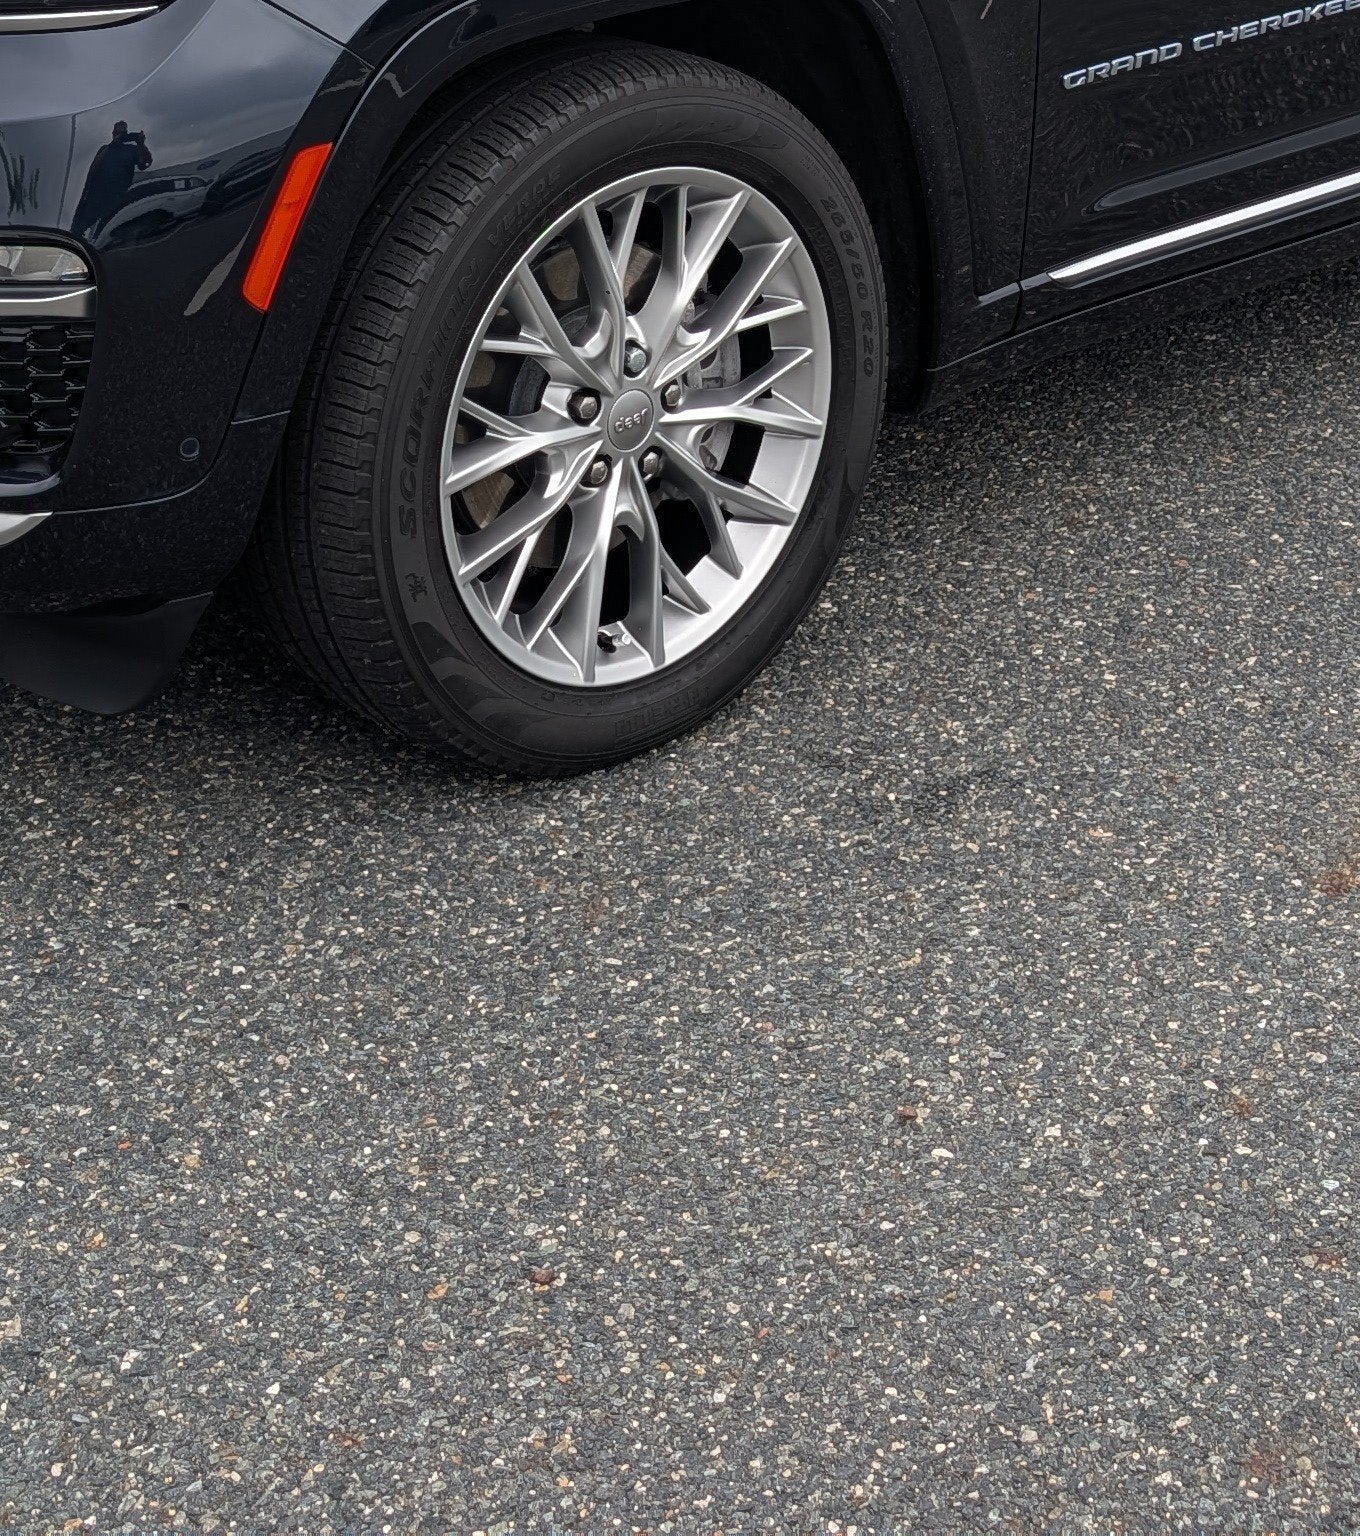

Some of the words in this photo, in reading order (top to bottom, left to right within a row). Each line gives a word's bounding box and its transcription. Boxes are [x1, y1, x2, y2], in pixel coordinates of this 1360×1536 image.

[1062, 42, 1183, 90] GRAND
[397, 257, 482, 540] SCORPION
[614, 408, 648, 433] Jeep
